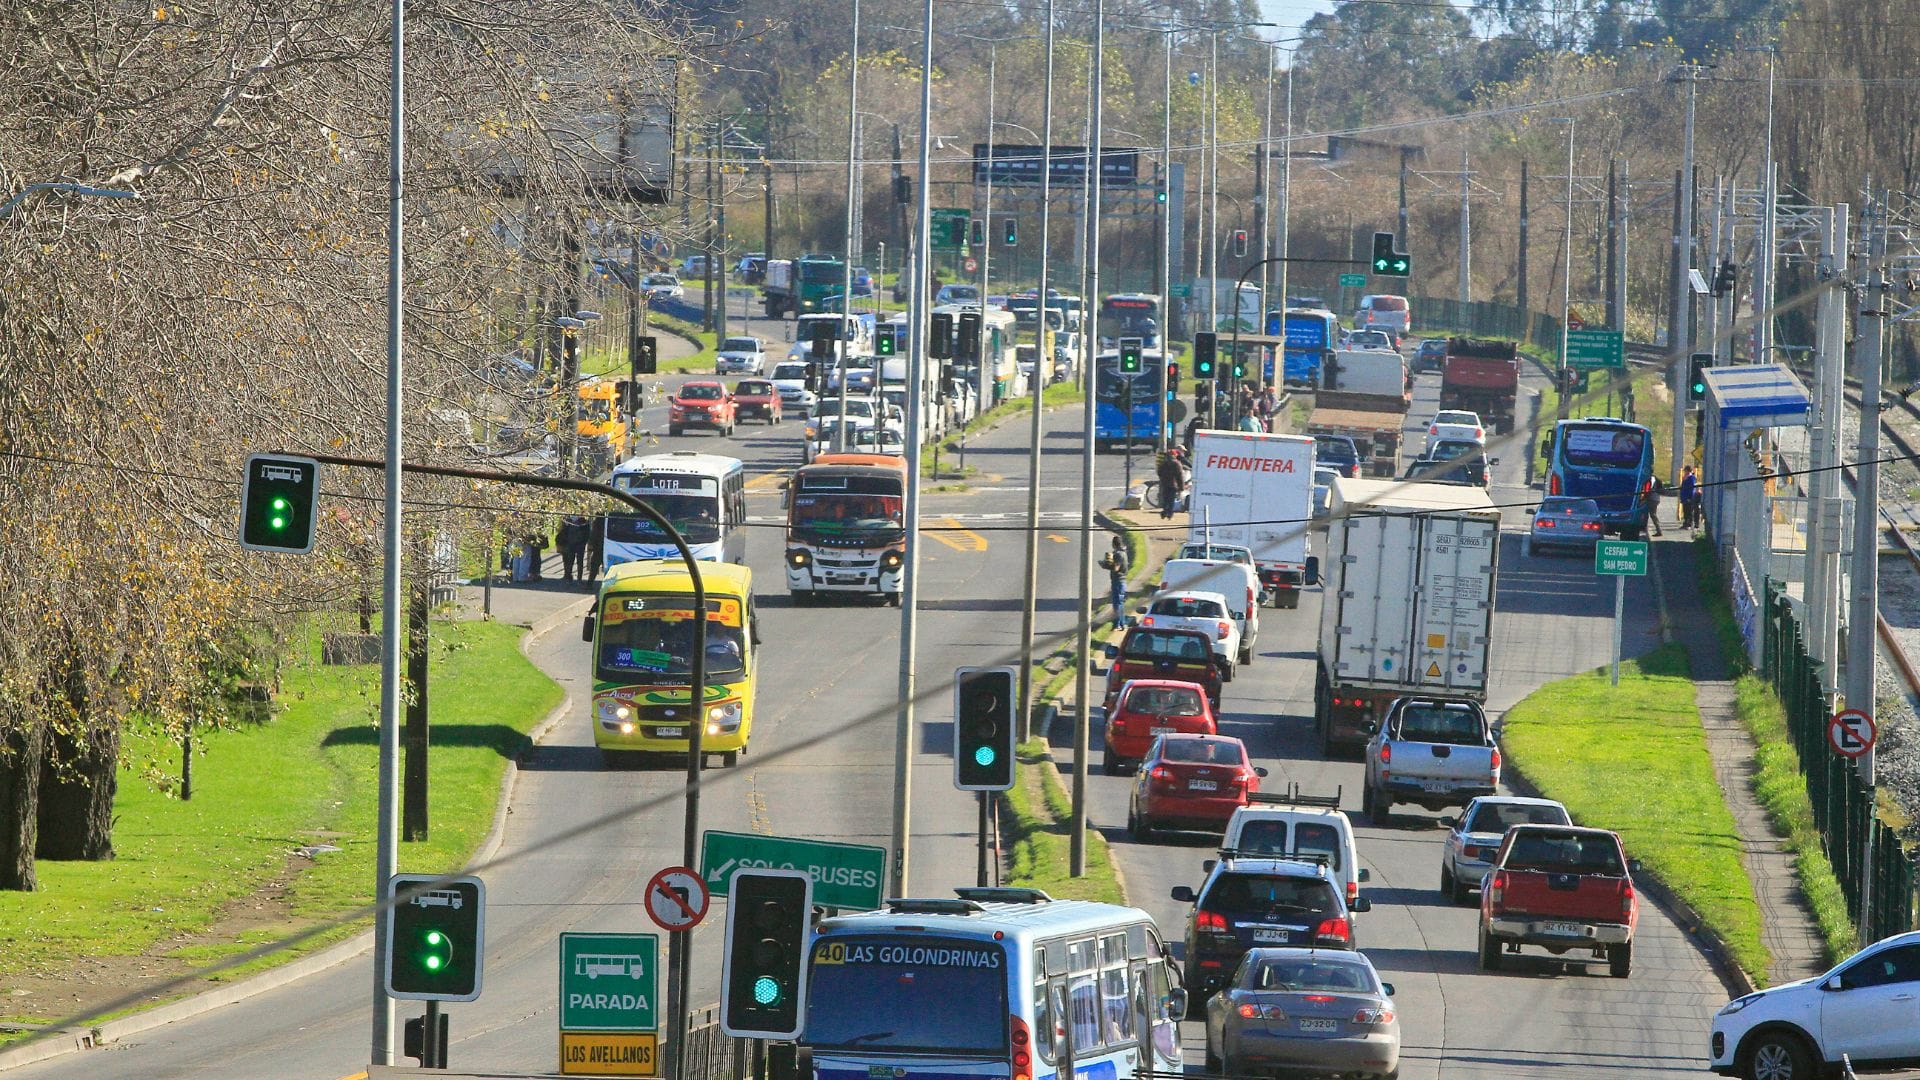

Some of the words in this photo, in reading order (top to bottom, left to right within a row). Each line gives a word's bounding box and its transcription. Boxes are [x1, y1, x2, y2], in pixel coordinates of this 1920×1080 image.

[1206, 454, 1293, 474] FRONTERA
[652, 479, 679, 489] LOTA
[1604, 546, 1628, 556] CESFAM
[1603, 559, 1616, 570] SAN
[1616, 560, 1637, 571] PEDRO
[617, 652, 631, 661] 300
[808, 864, 877, 888] BUSES
[818, 943, 844, 962] 40
[844, 945, 874, 963] LAS
[879, 946, 1000, 969] GOLONDRINAS
[569, 993, 649, 1010] PARADA
[565, 1045, 586, 1063] LOS
[589, 1045, 651, 1064] AVELLANOS
